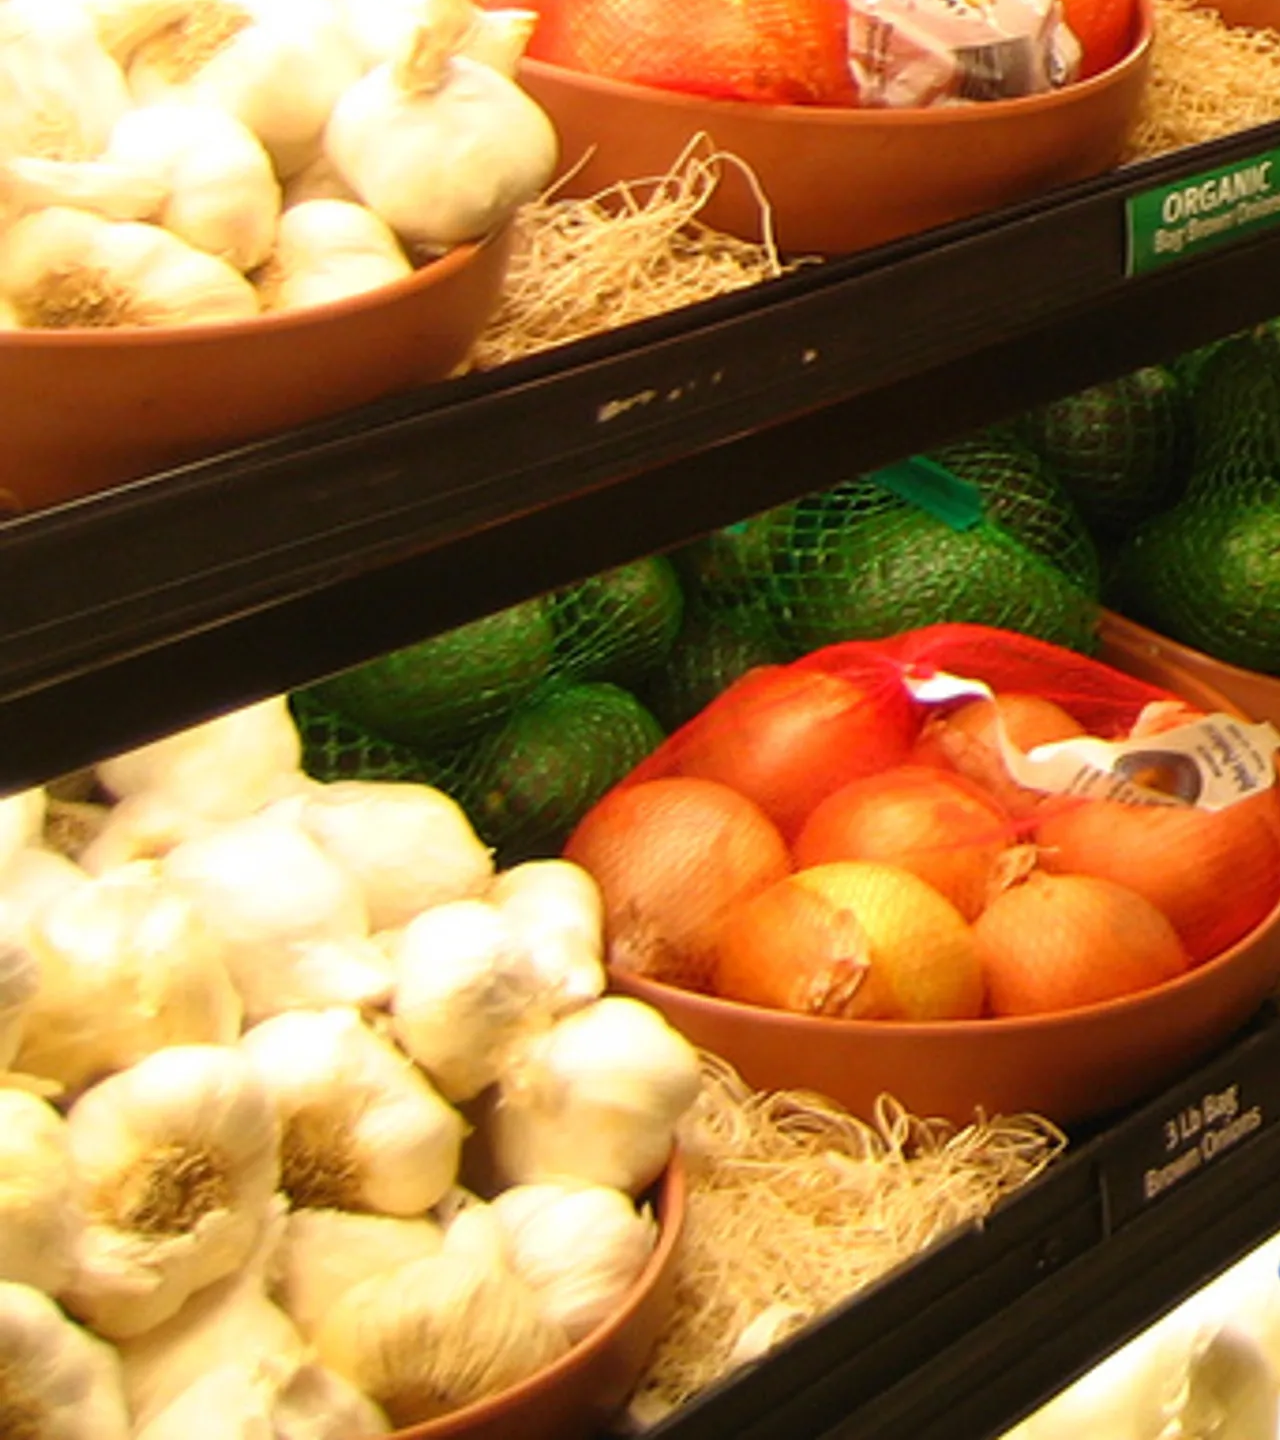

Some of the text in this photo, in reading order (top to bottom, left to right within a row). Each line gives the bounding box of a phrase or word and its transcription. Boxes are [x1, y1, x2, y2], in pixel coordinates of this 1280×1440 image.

[1162, 160, 1273, 224] ORGANIC
[1164, 1118, 1178, 1151] 3
[1203, 1106, 1262, 1160] Onions
